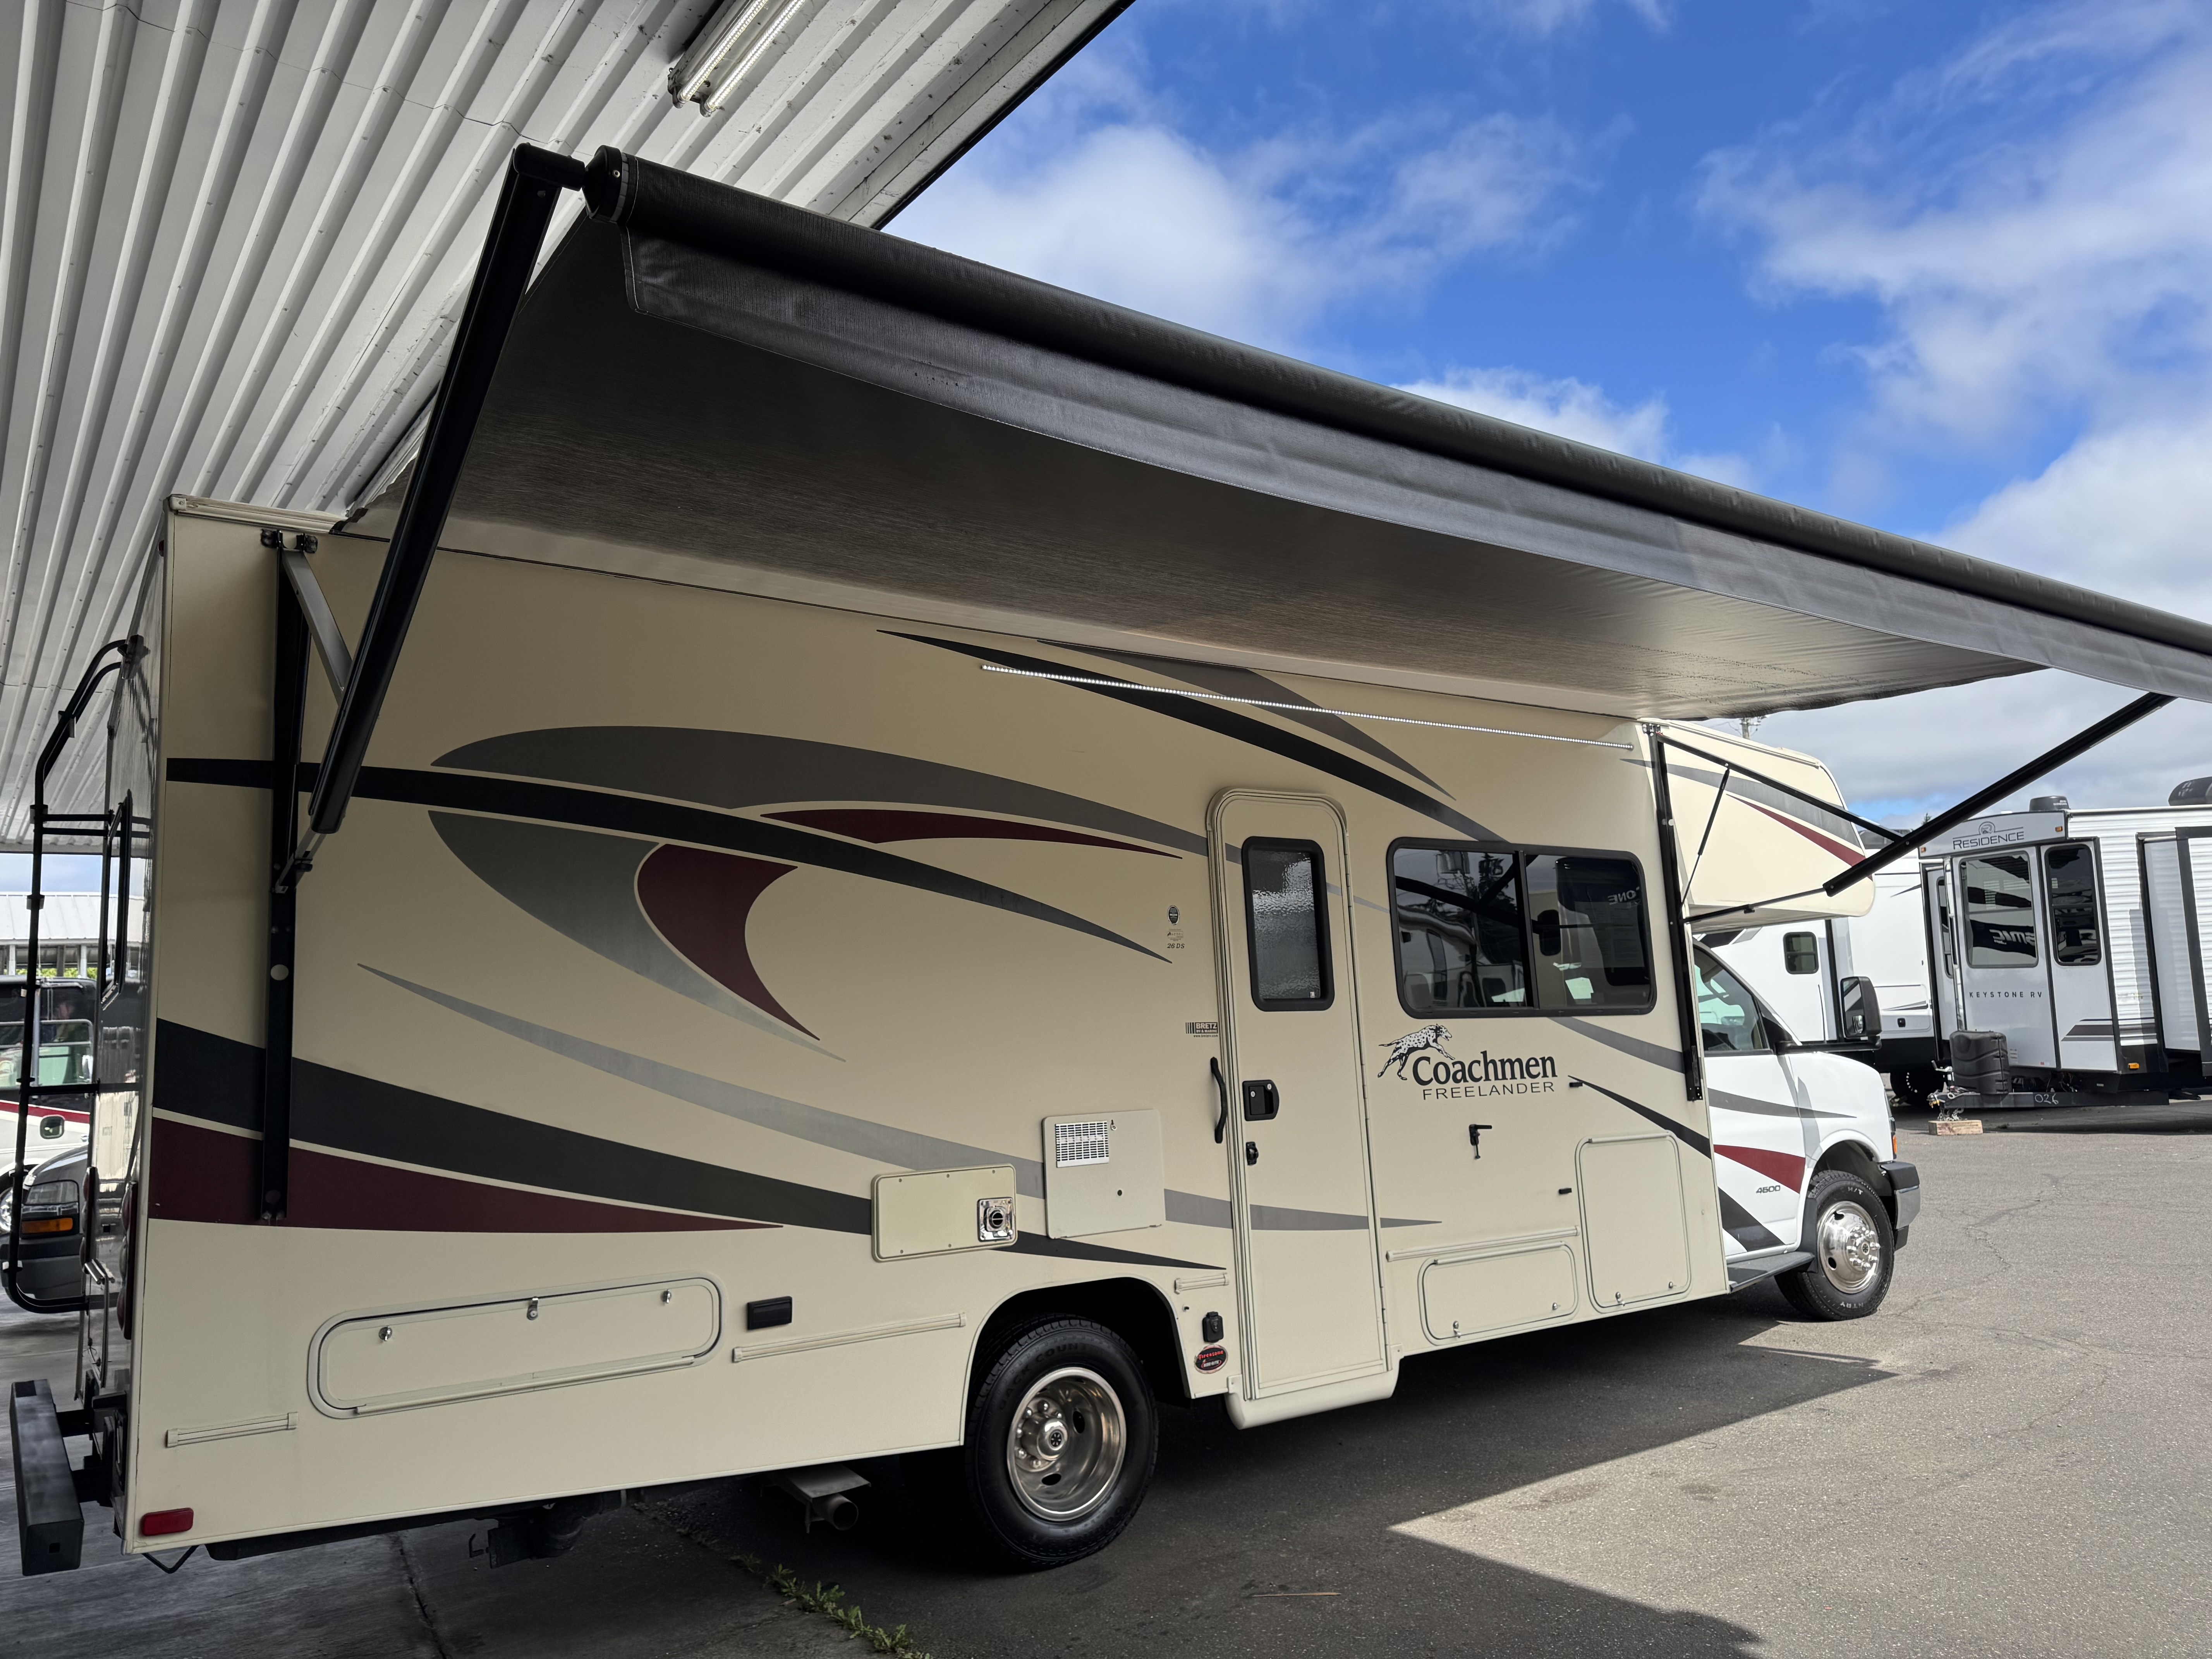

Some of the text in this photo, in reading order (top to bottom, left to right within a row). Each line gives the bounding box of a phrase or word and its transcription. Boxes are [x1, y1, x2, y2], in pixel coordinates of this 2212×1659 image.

[1953, 831, 2025, 850] RESIDENCE
[1412, 1050, 1558, 1086] Coachmen
[1422, 1081, 1555, 1100] FREELANDER
[1755, 1185, 1781, 1194] 4500
